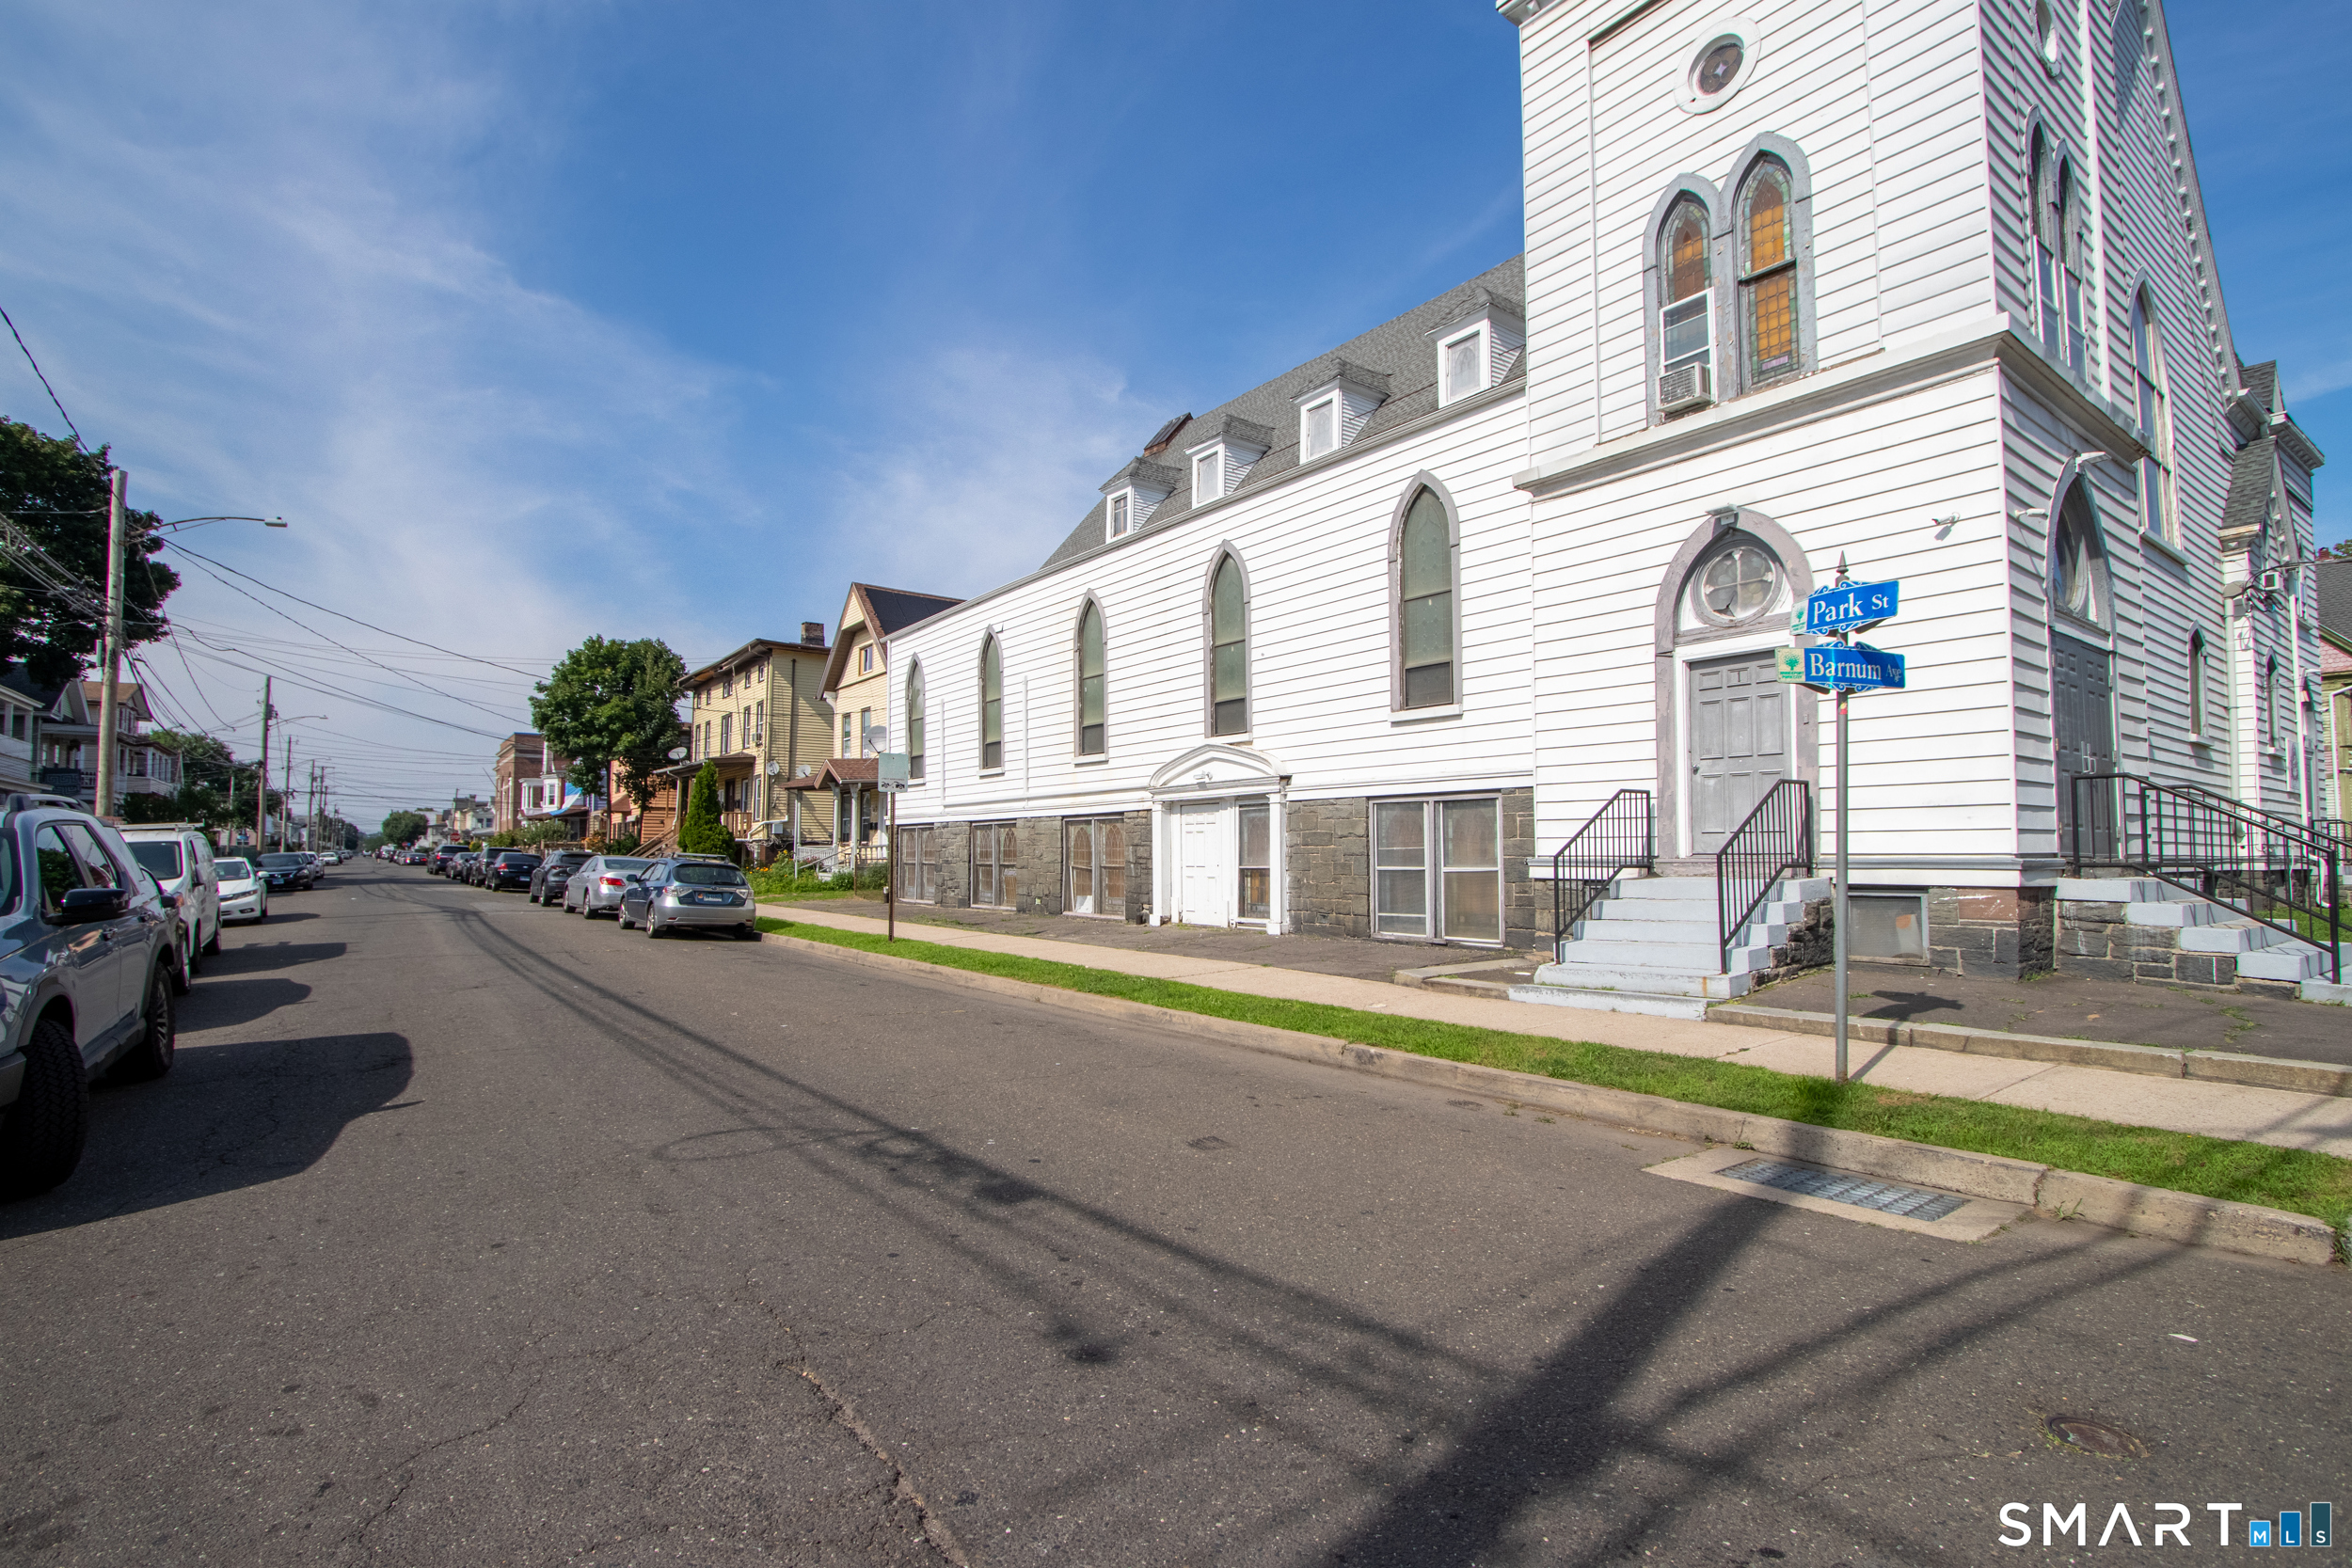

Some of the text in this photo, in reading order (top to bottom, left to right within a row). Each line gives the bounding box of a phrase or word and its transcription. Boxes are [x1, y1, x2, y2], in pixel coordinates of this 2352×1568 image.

[1812, 593, 1889, 625] Park St
[1809, 653, 1901, 680] Barnum Ave
